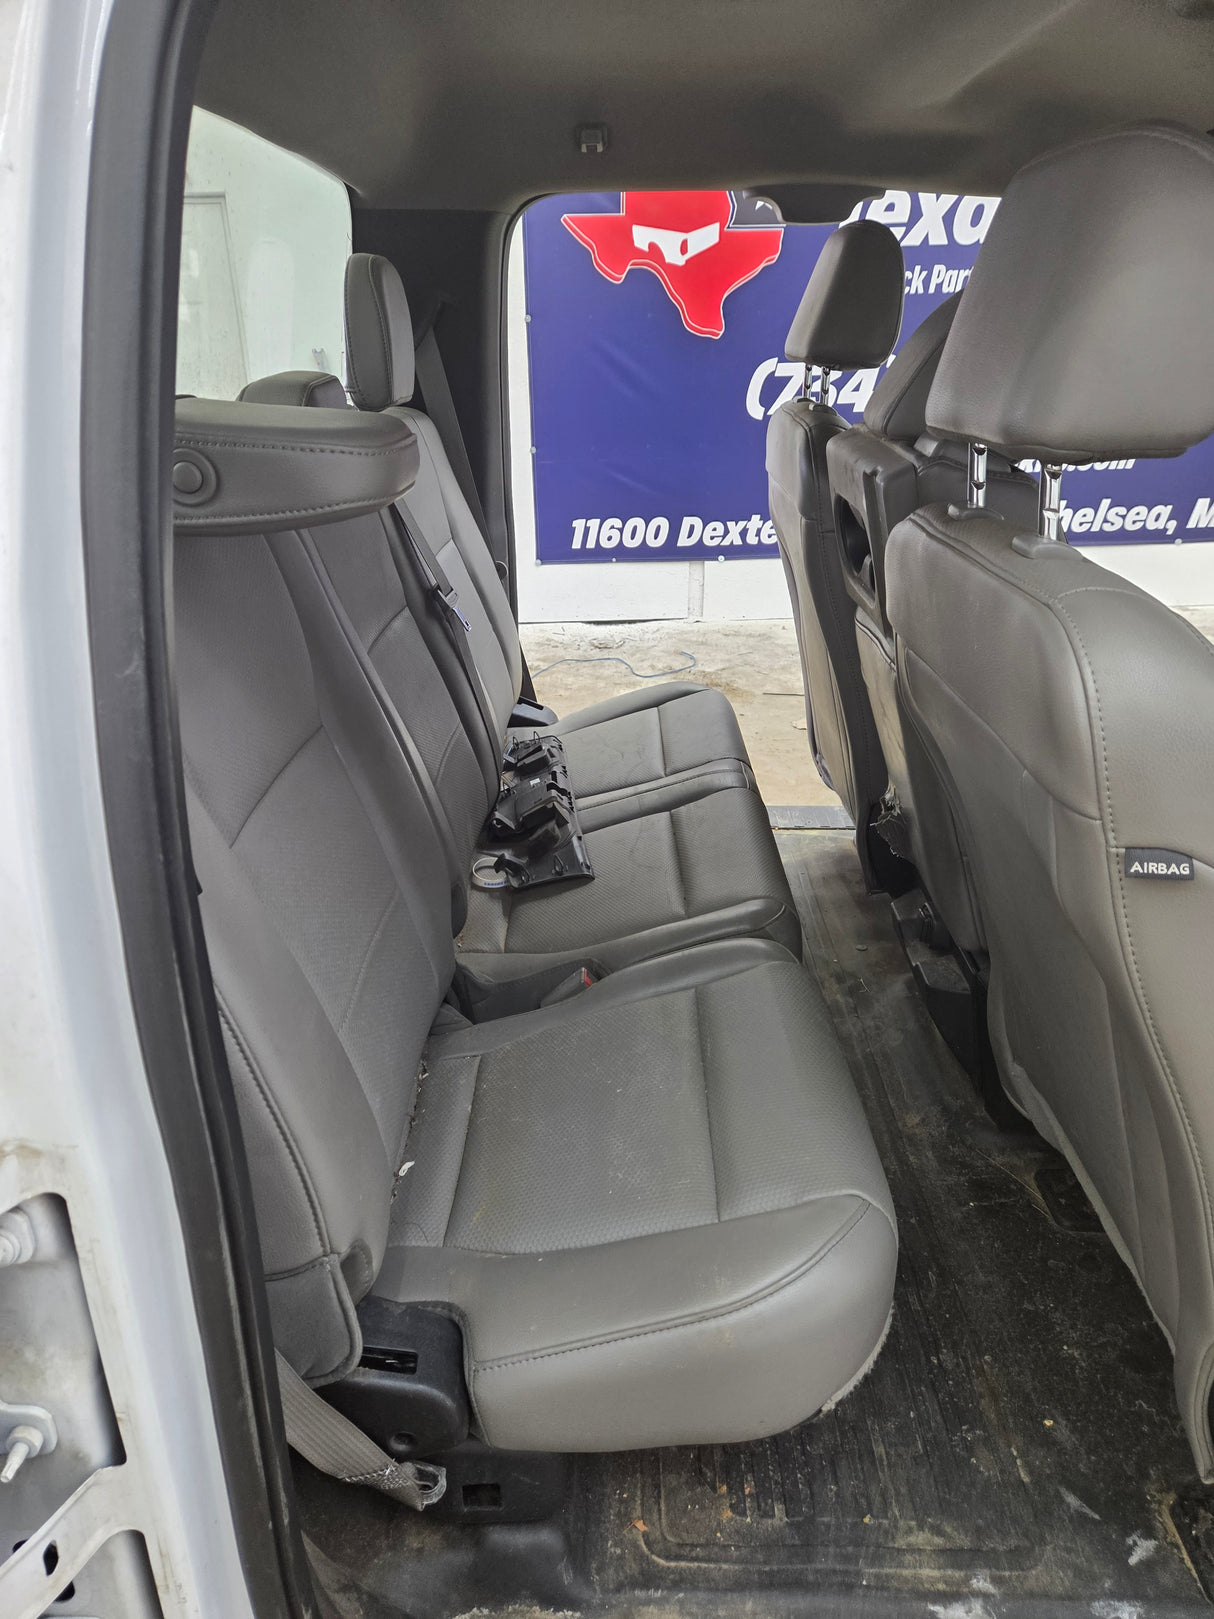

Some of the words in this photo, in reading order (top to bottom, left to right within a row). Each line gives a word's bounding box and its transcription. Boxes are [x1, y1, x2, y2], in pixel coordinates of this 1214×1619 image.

[838, 190, 1002, 247] exa
[928, 264, 974, 294] Par
[746, 354, 896, 421] (734
[571, 517, 669, 549] 11600
[677, 514, 777, 547] Dexte
[1130, 861, 1190, 875] AIRBAG
